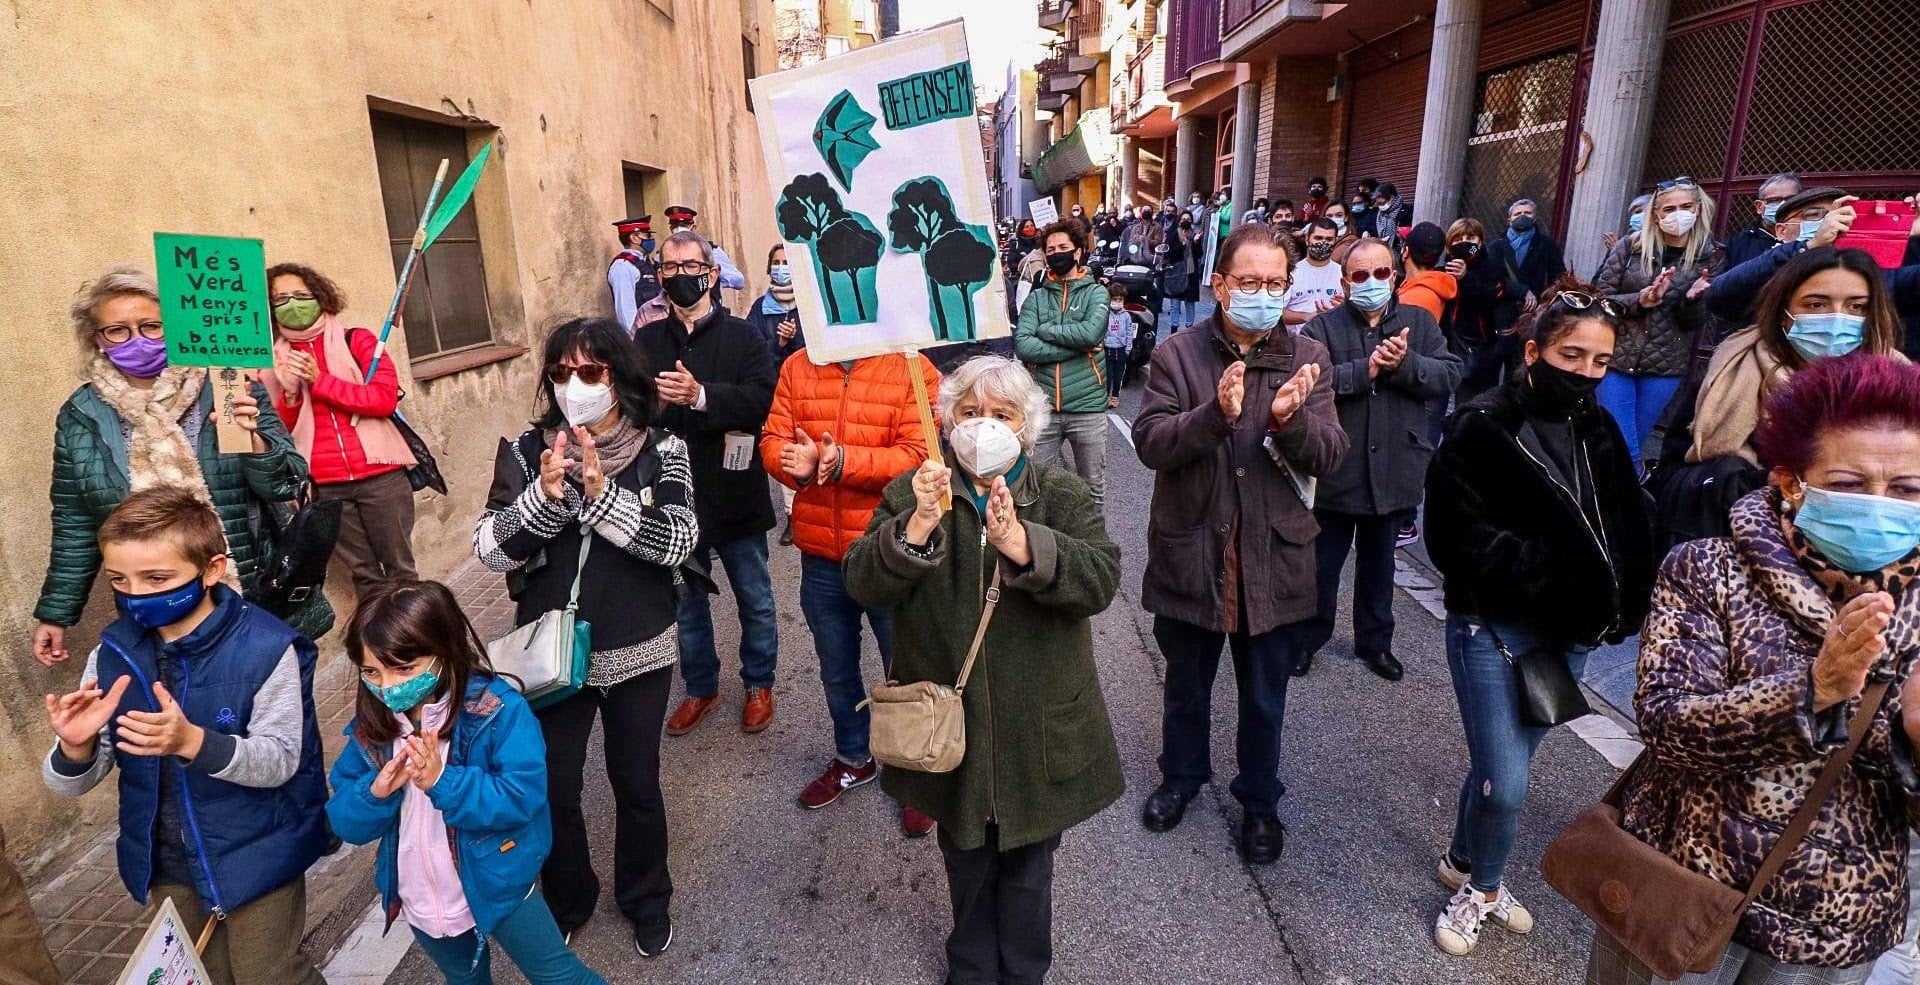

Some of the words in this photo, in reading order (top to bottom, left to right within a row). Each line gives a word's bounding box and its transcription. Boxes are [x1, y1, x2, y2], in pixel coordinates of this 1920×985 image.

[880, 63, 972, 129] DEFENSEM
[174, 245, 241, 271] Més
[187, 273, 247, 292] Verd
[181, 294, 248, 315] Menys
[202, 313, 243, 328] gris
[178, 343, 270, 356] biodiversa
